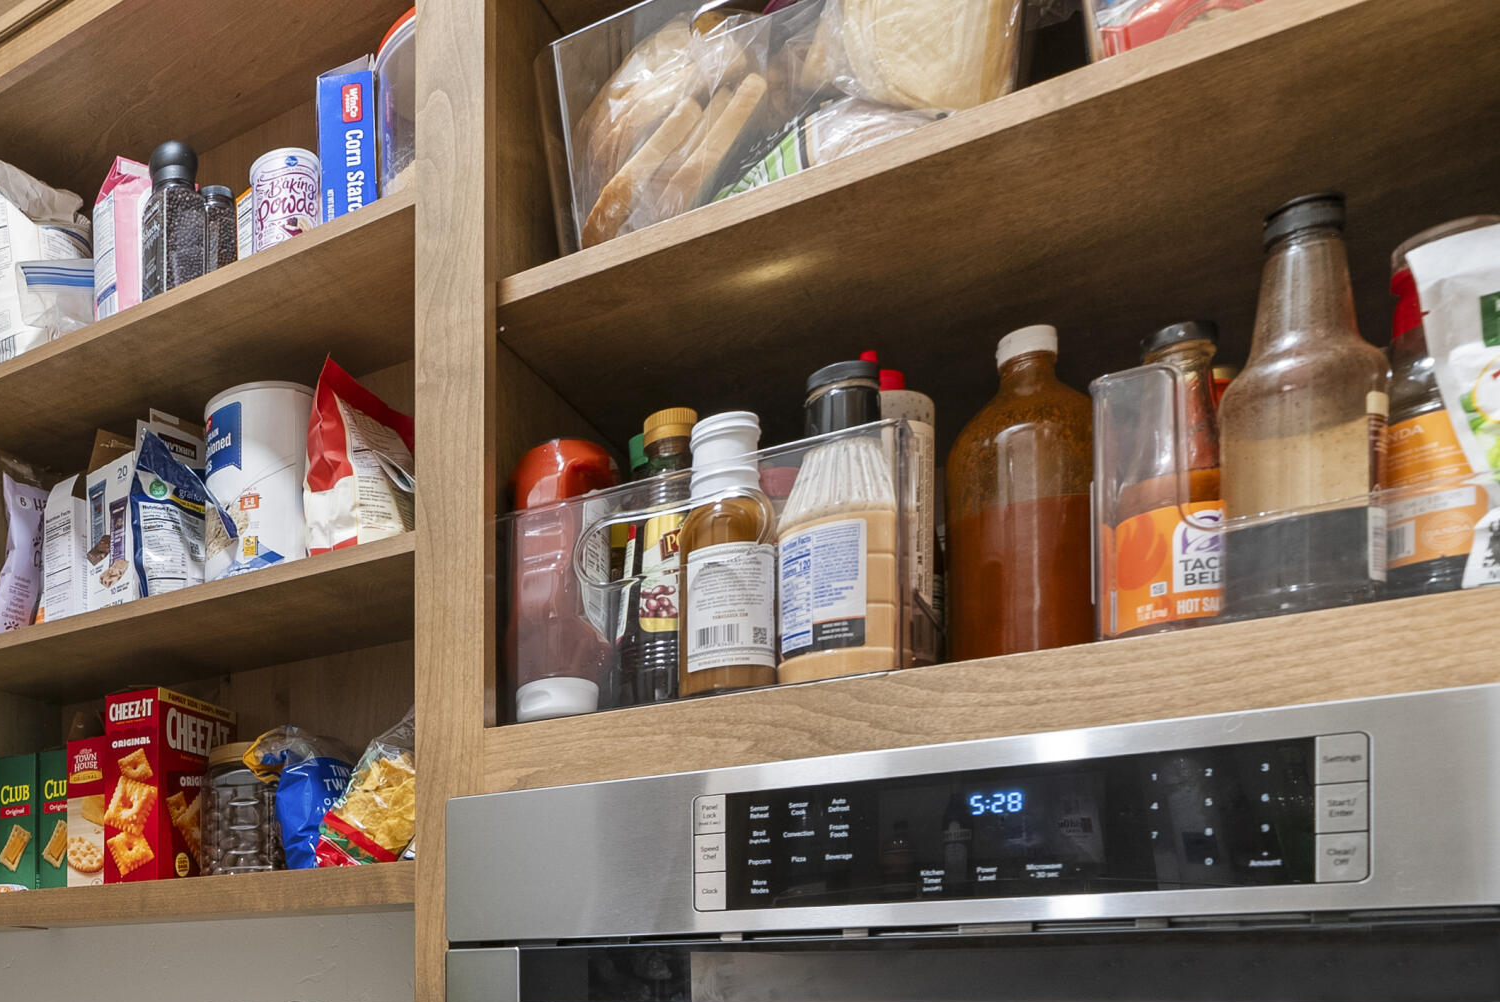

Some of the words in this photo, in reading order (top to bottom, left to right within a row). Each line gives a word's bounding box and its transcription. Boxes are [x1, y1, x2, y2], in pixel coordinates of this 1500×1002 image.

[349, 87, 358, 118] WinCo
[345, 129, 364, 167] Corn
[268, 177, 317, 200] Baking
[346, 170, 366, 213] Starc
[257, 190, 316, 231] Powde
[117, 465, 128, 480] 20
[1179, 556, 1219, 572] TAC
[1176, 599, 1200, 614] HOT
[74, 752, 97, 763] TOWN
[1321, 752, 1363, 765] Settings
[74, 761, 98, 773] HOUSE
[1204, 766, 1213, 778] 2
[1260, 761, 1270, 773] 3
[1151, 772, 1158, 781] 1
[0, 784, 31, 805] CLUB
[44, 779, 67, 800] CLU
[1204, 796, 1213, 807] 5
[1260, 791, 1270, 802] 6
[788, 801, 809, 809] Sensor
[969, 791, 1023, 816] 5:28
[1150, 800, 1159, 810] 4
[1326, 798, 1357, 808] Start/
[5, 807, 25, 818] Original
[827, 804, 851, 813] Defrost
[1327, 807, 1355, 818] Enter
[828, 823, 850, 831] Frozen
[1204, 826, 1213, 837] 8
[1260, 822, 1270, 833] 9
[752, 829, 767, 837] Broil
[782, 829, 816, 839] Convection
[829, 830, 849, 838] Foods
[1151, 830, 1159, 839] 7
[700, 845, 720, 853] Speed
[1325, 847, 1357, 857] Clear/
[702, 853, 717, 861] Chef
[748, 857, 772, 866] Popcorn
[791, 854, 807, 863] Pizza
[824, 852, 854, 861] Beverage
[1204, 856, 1213, 867] 0
[1025, 862, 1064, 872] Microwave
[1248, 857, 1282, 867] Amount
[1333, 857, 1350, 867] Off
[919, 869, 946, 877] Kitchen
[975, 866, 998, 874] Power
[1036, 870, 1047, 880] 30
[1048, 870, 1060, 879] sec
[923, 876, 942, 884] Timer
[977, 873, 997, 882] Level
[701, 887, 718, 895] Clock
[750, 886, 770, 894] Modes
